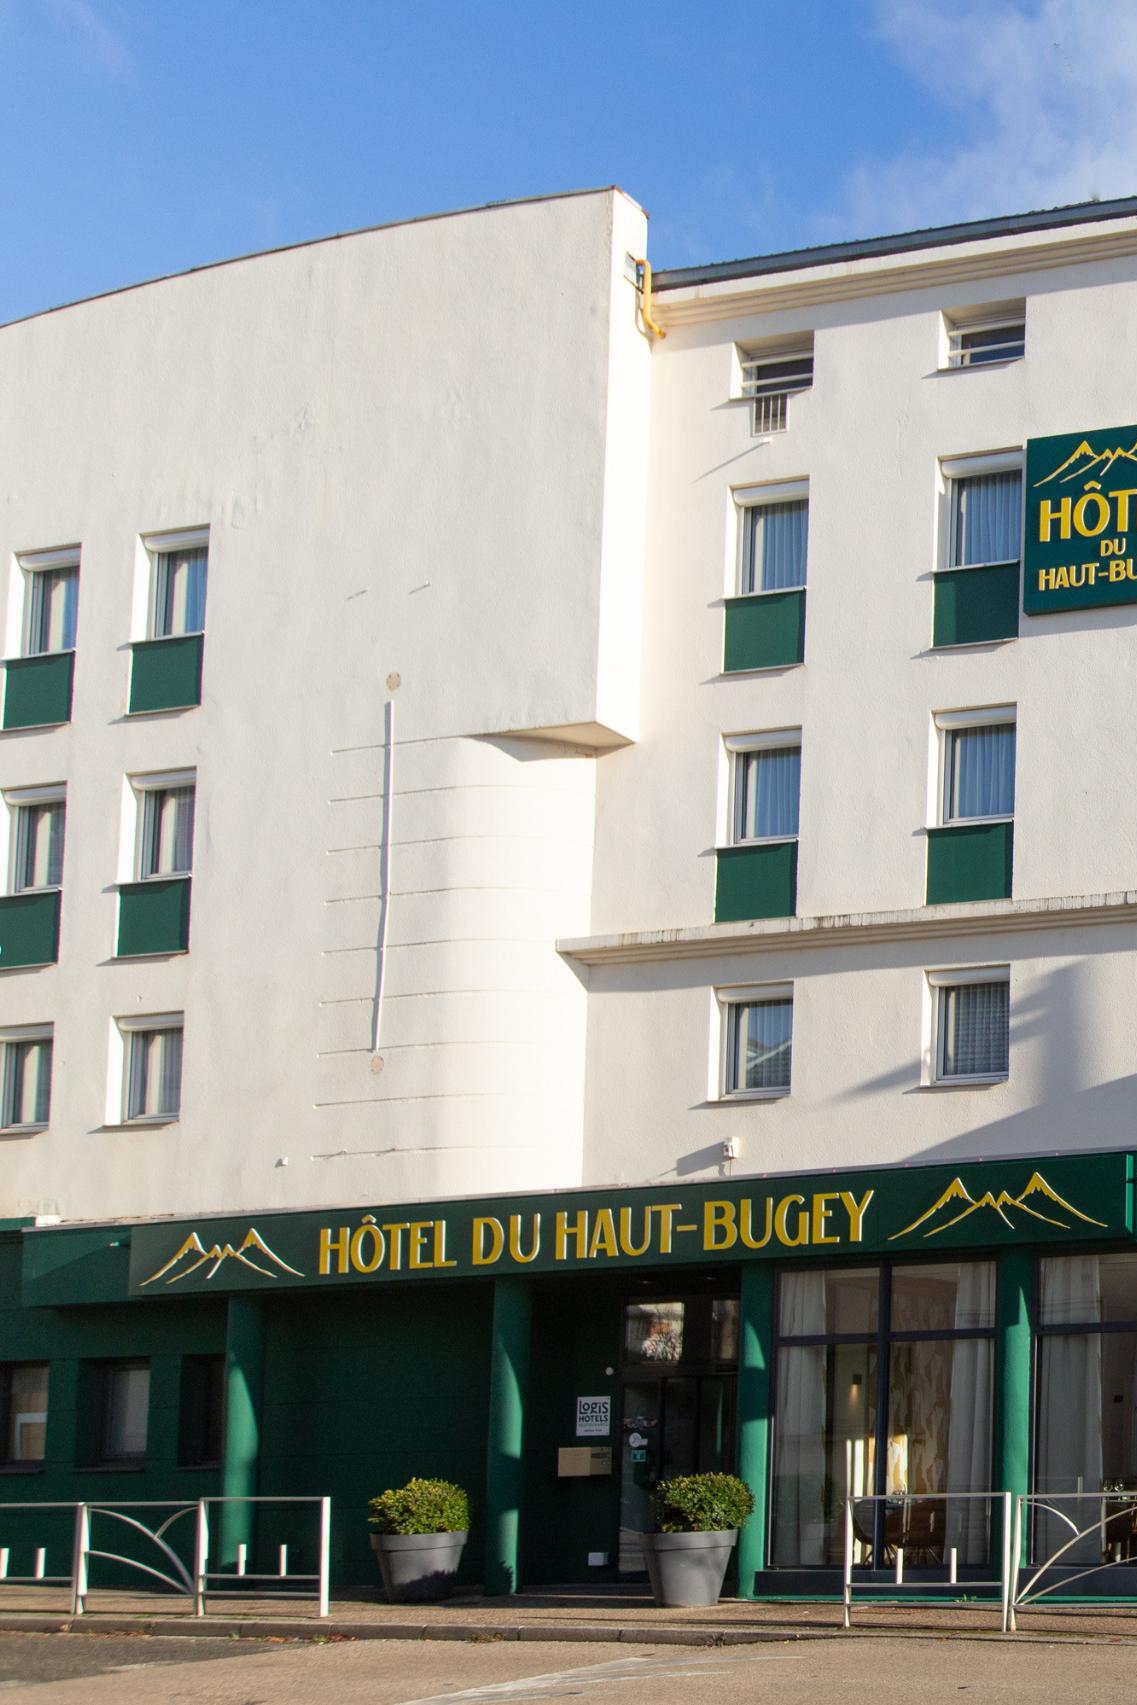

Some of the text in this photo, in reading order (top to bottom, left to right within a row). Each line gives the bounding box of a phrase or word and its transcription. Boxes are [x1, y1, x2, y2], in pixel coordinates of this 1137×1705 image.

[1100, 538, 1126, 557] DU
[319, 1190, 875, 1275] HÔTEL DU HAUT-BUGEY
[578, 1414, 609, 1423] HOTELS
